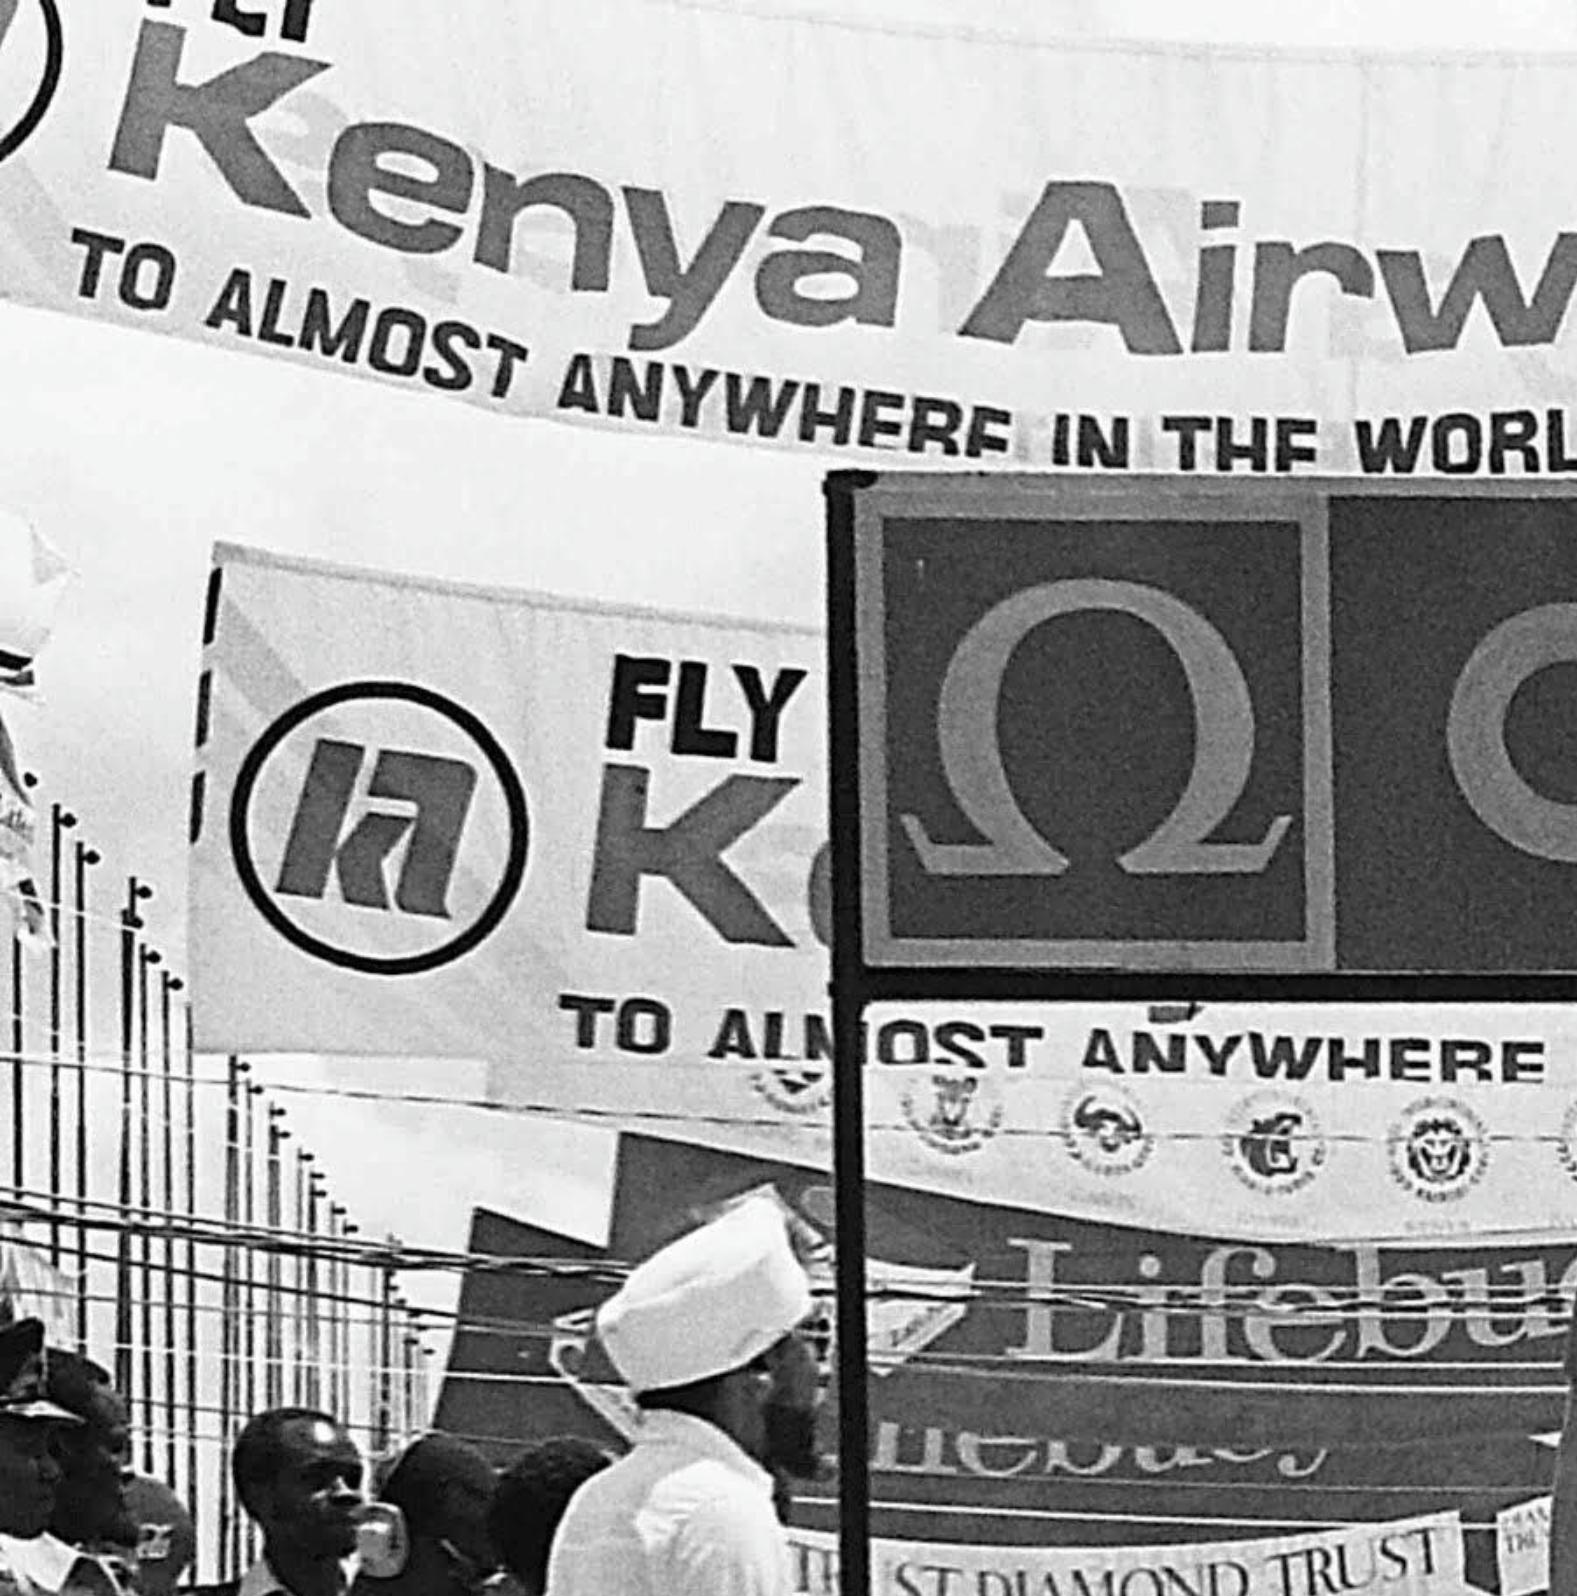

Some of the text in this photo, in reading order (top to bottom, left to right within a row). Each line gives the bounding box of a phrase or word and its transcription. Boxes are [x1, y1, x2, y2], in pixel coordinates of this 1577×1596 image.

[107, 17, 903, 350] Kenya
[70, 228, 176, 311] TO
[205, 269, 529, 399] ALMOST
[557, 353, 1011, 462] ANYWHERE
[1052, 413, 1130, 469] IN
[1162, 416, 1317, 472] THE
[606, 653, 807, 762] FLY
[558, 993, 673, 1053] TO
[1081, 1028, 1546, 1084] ANYWHERE
